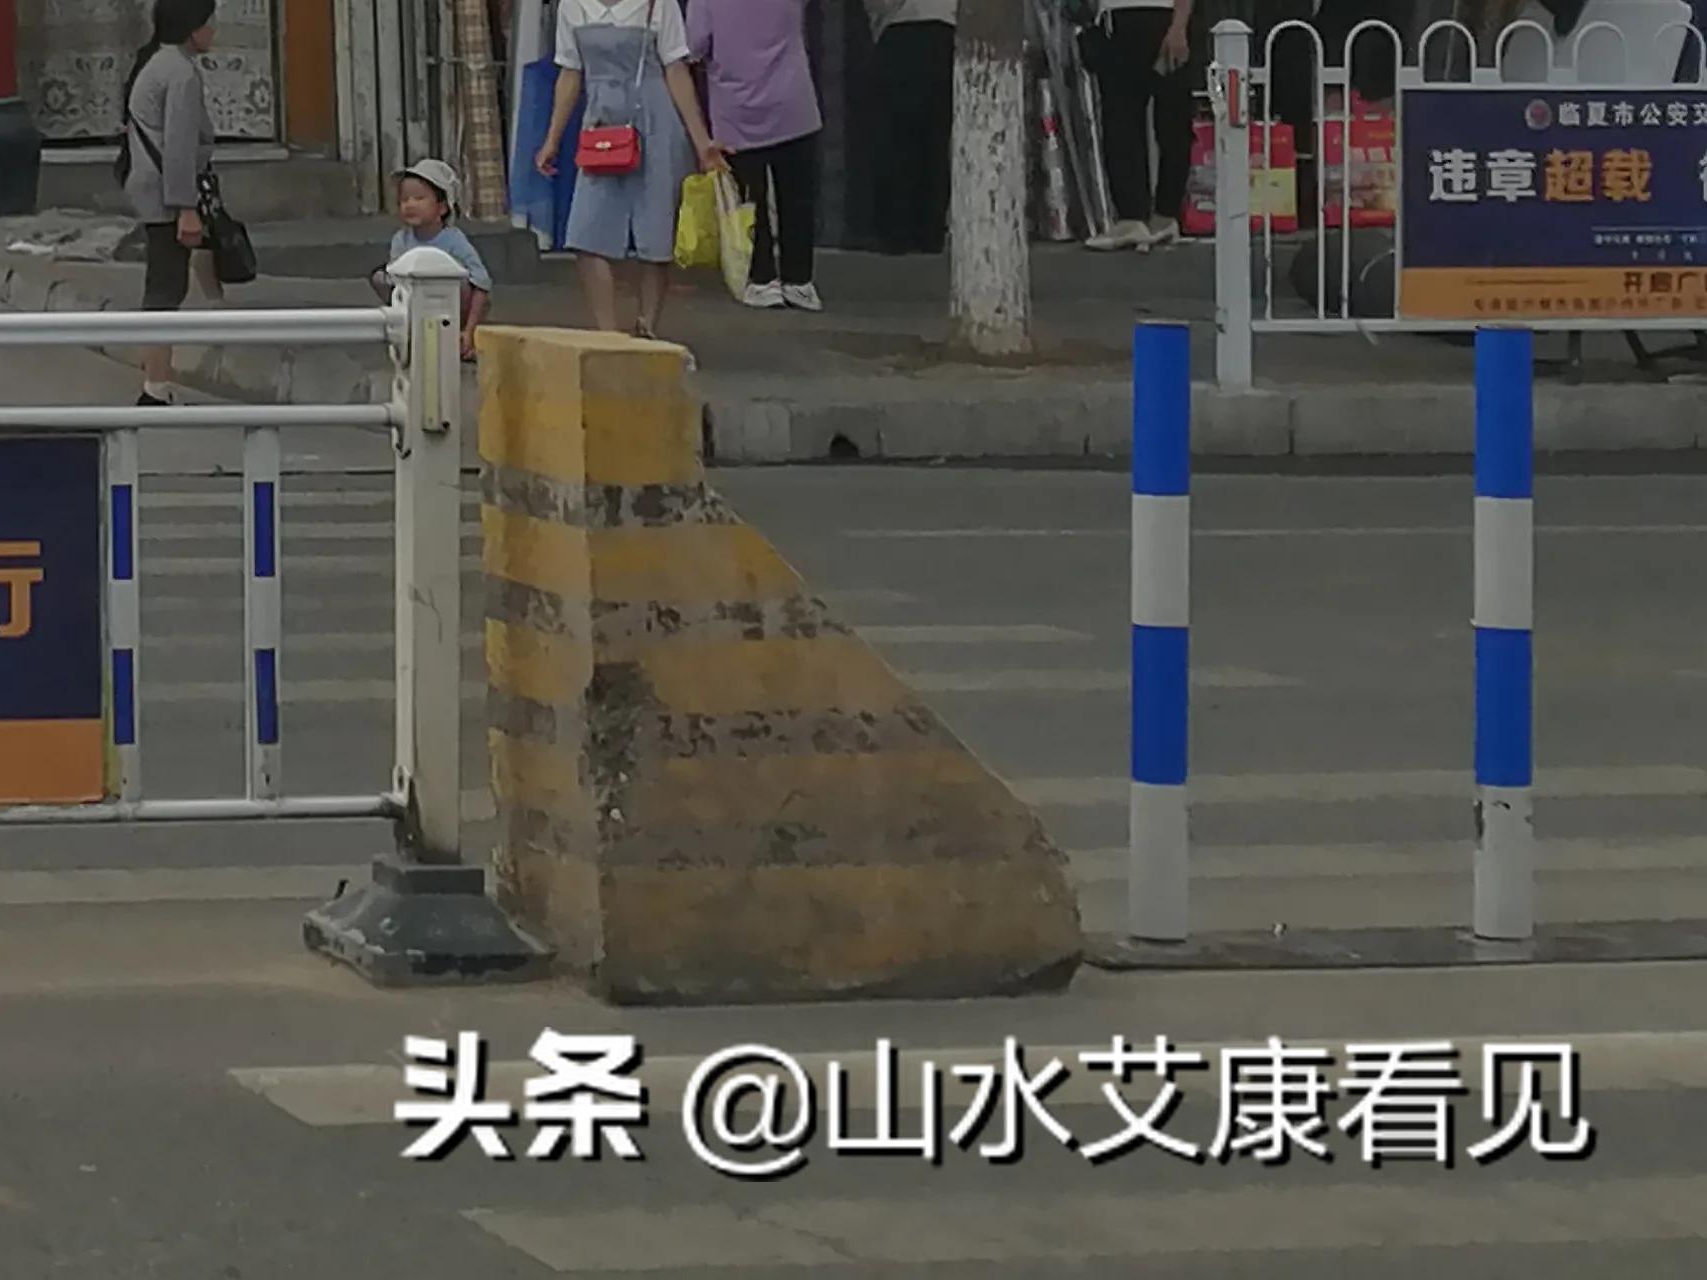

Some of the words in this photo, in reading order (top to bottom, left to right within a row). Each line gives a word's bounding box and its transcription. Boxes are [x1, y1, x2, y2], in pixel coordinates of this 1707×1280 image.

[1428, 148, 1653, 204] 违章超载
[1623, 270, 1707, 294] 开启广
